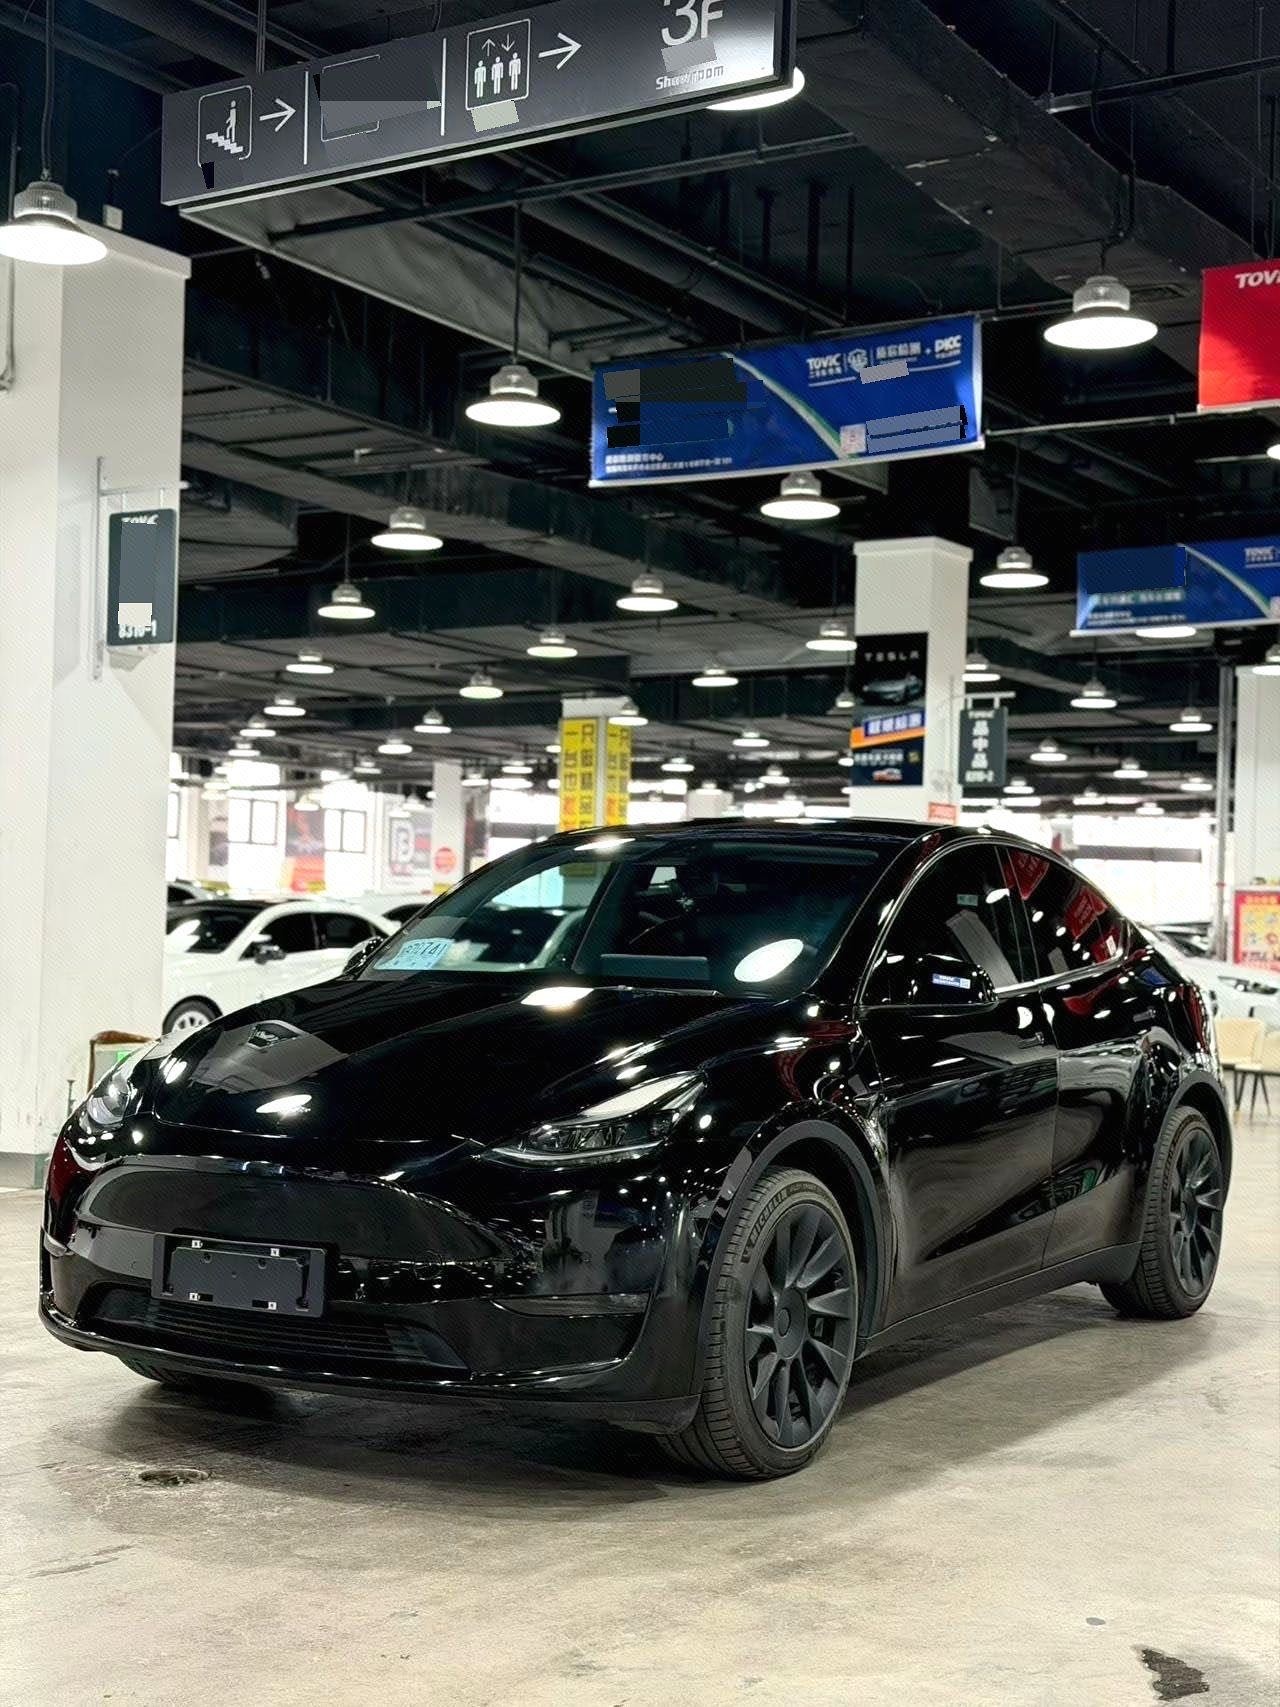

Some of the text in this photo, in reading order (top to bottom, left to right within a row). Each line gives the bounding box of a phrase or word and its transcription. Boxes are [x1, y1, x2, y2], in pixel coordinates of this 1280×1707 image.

[661, 0, 724, 46] 3F
[806, 353, 842, 371] TOVIC
[864, 650, 921, 662] TESLA
[750, 1188, 787, 1245] MICHELIN
